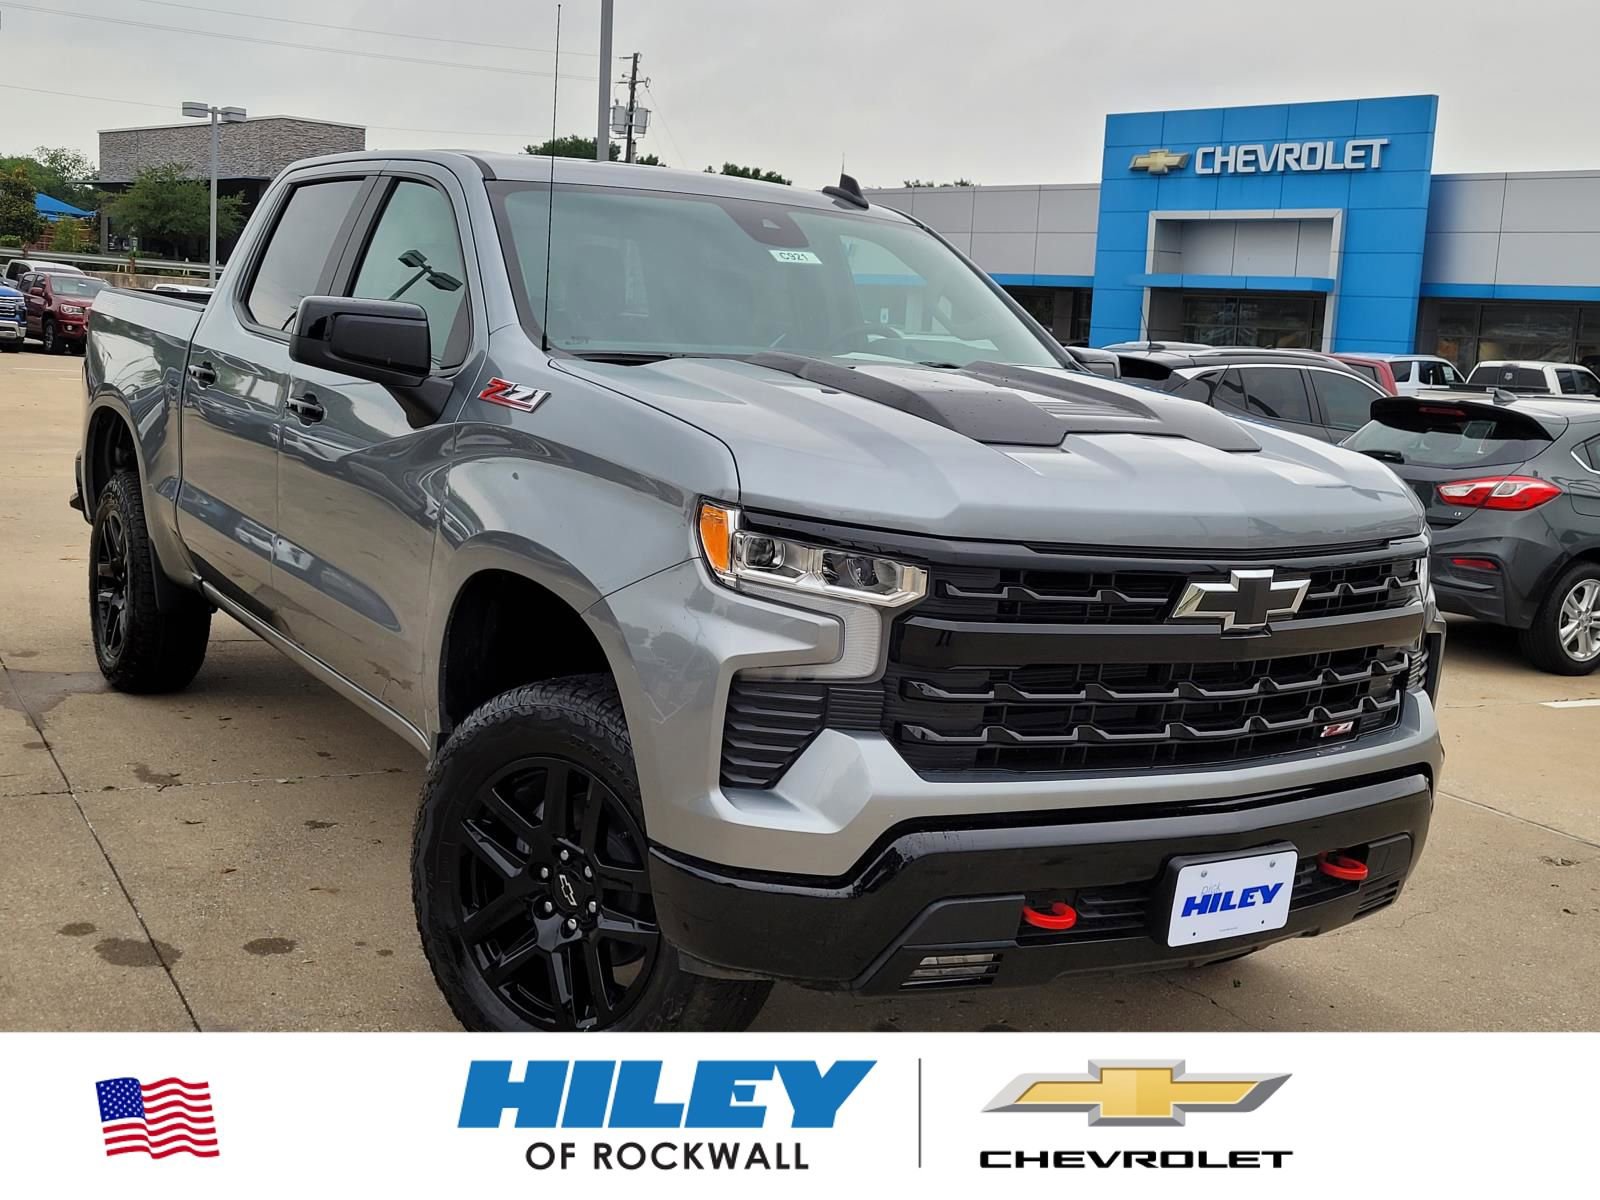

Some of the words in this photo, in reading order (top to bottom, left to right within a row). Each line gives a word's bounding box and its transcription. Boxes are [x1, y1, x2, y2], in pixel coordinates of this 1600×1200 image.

[1195, 138, 1389, 174] CHEVROLET
[477, 377, 552, 413] Z71
[1181, 882, 1284, 917] HILEY
